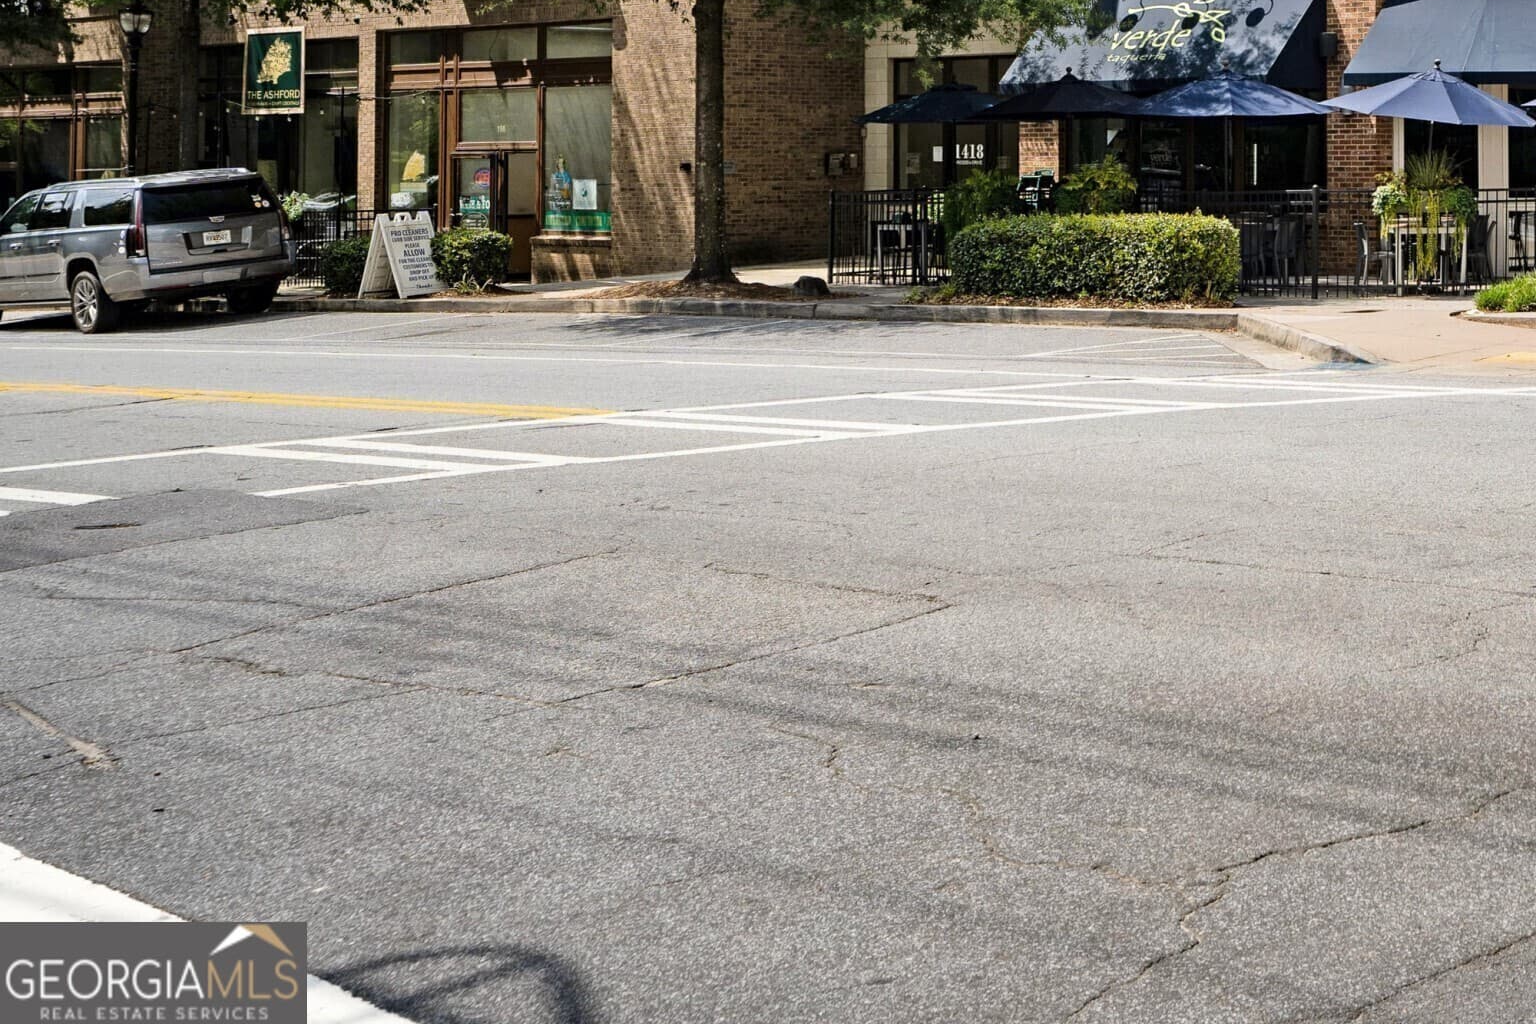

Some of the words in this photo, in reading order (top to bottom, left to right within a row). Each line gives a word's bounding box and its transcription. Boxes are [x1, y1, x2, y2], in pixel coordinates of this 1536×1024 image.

[1111, 19, 1191, 50] verde
[247, 90, 262, 99] THE
[263, 89, 300, 99] ASHFORD
[955, 143, 984, 159] 1418
